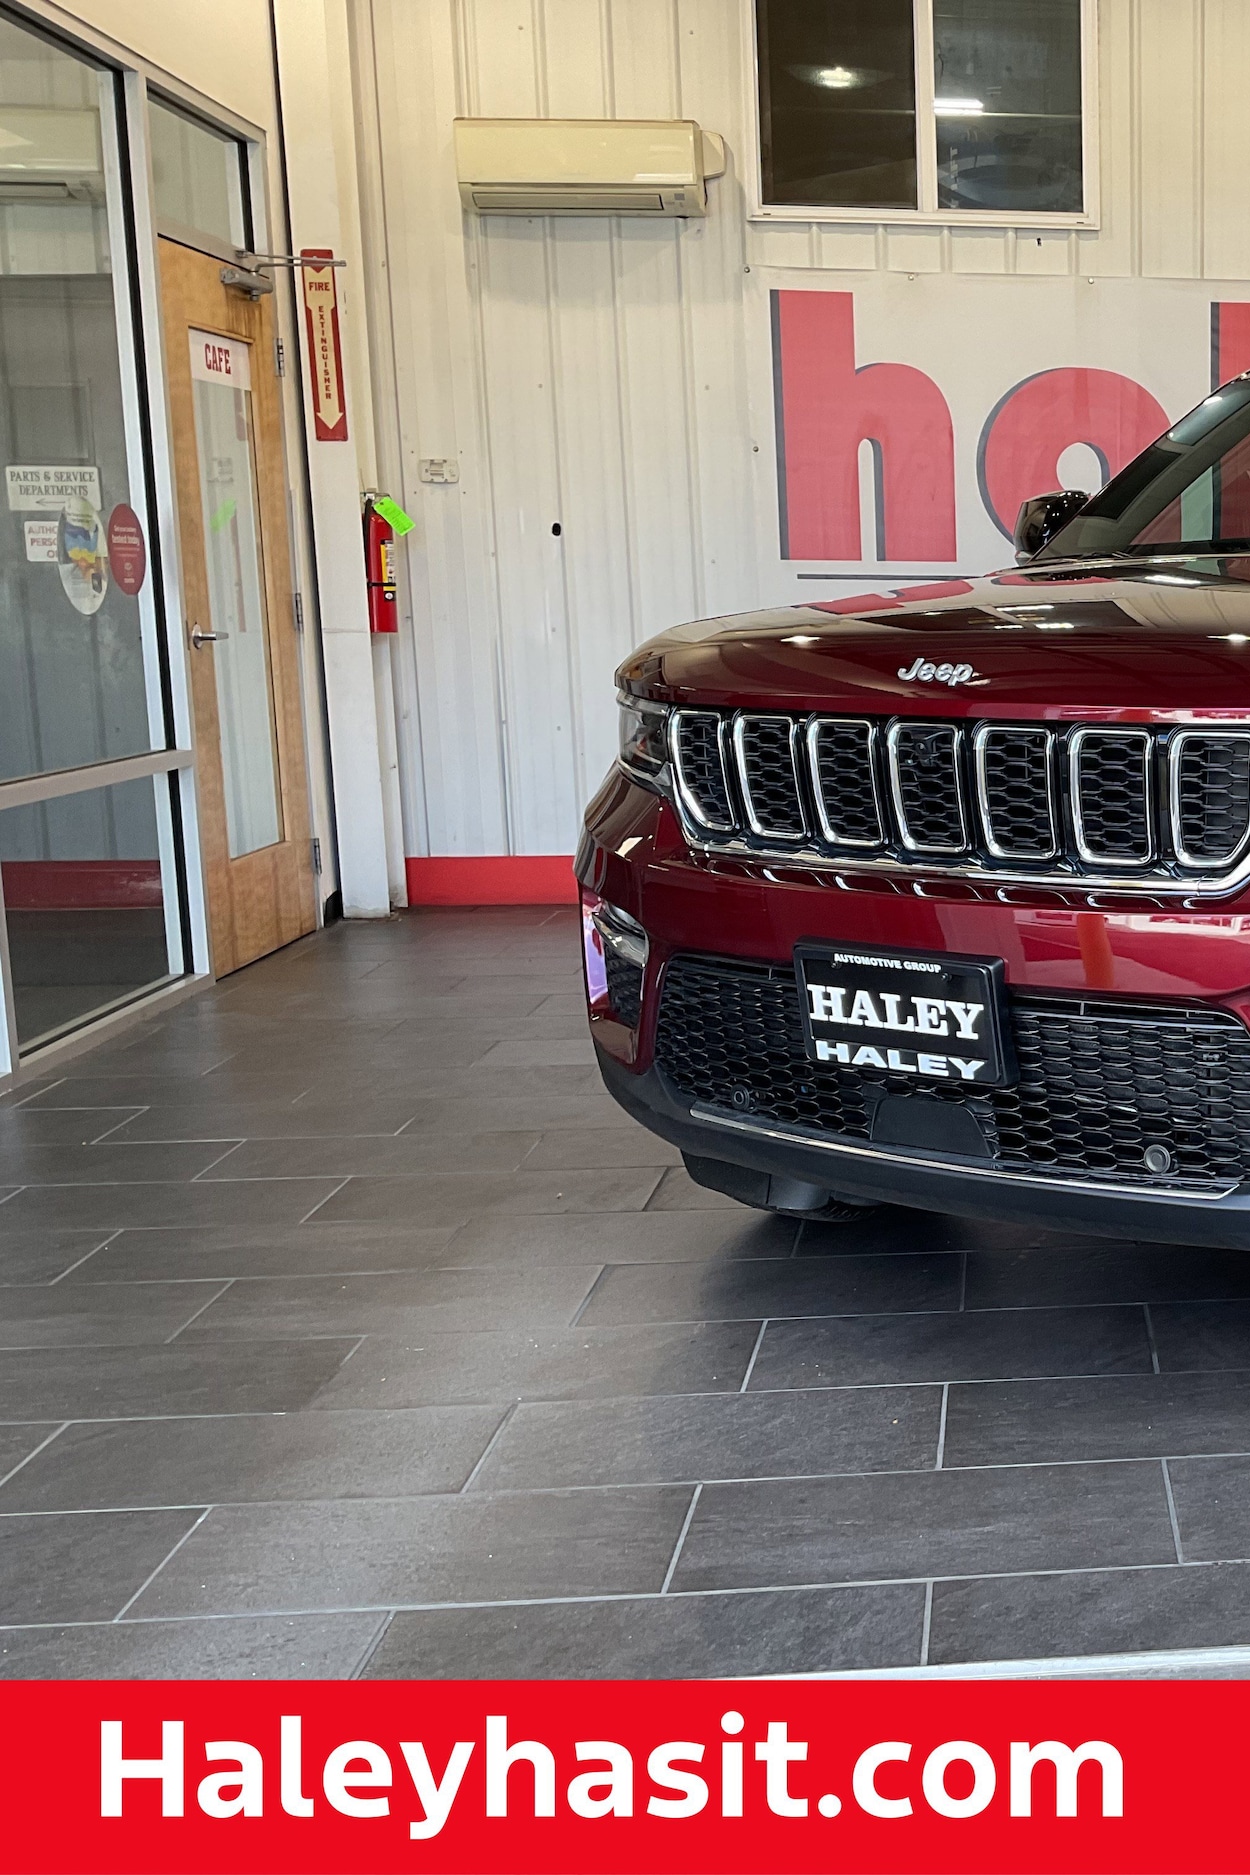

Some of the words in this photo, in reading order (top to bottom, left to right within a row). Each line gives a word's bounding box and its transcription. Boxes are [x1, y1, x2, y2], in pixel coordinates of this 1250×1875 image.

[309, 281, 331, 292] FIRE
[204, 343, 232, 375] CAFE
[318, 305, 332, 400] EXTINGUISHER
[10, 470, 41, 482] PARTS
[54, 471, 95, 483] SERVICE
[19, 484, 89, 497] DEPARTMENTS
[897, 657, 974, 687] Jeep
[833, 953, 903, 970] AUTOMOTIVE
[903, 960, 942, 974] GROUP
[806, 983, 984, 1040] HALEY
[815, 1039, 985, 1080] HALEY
